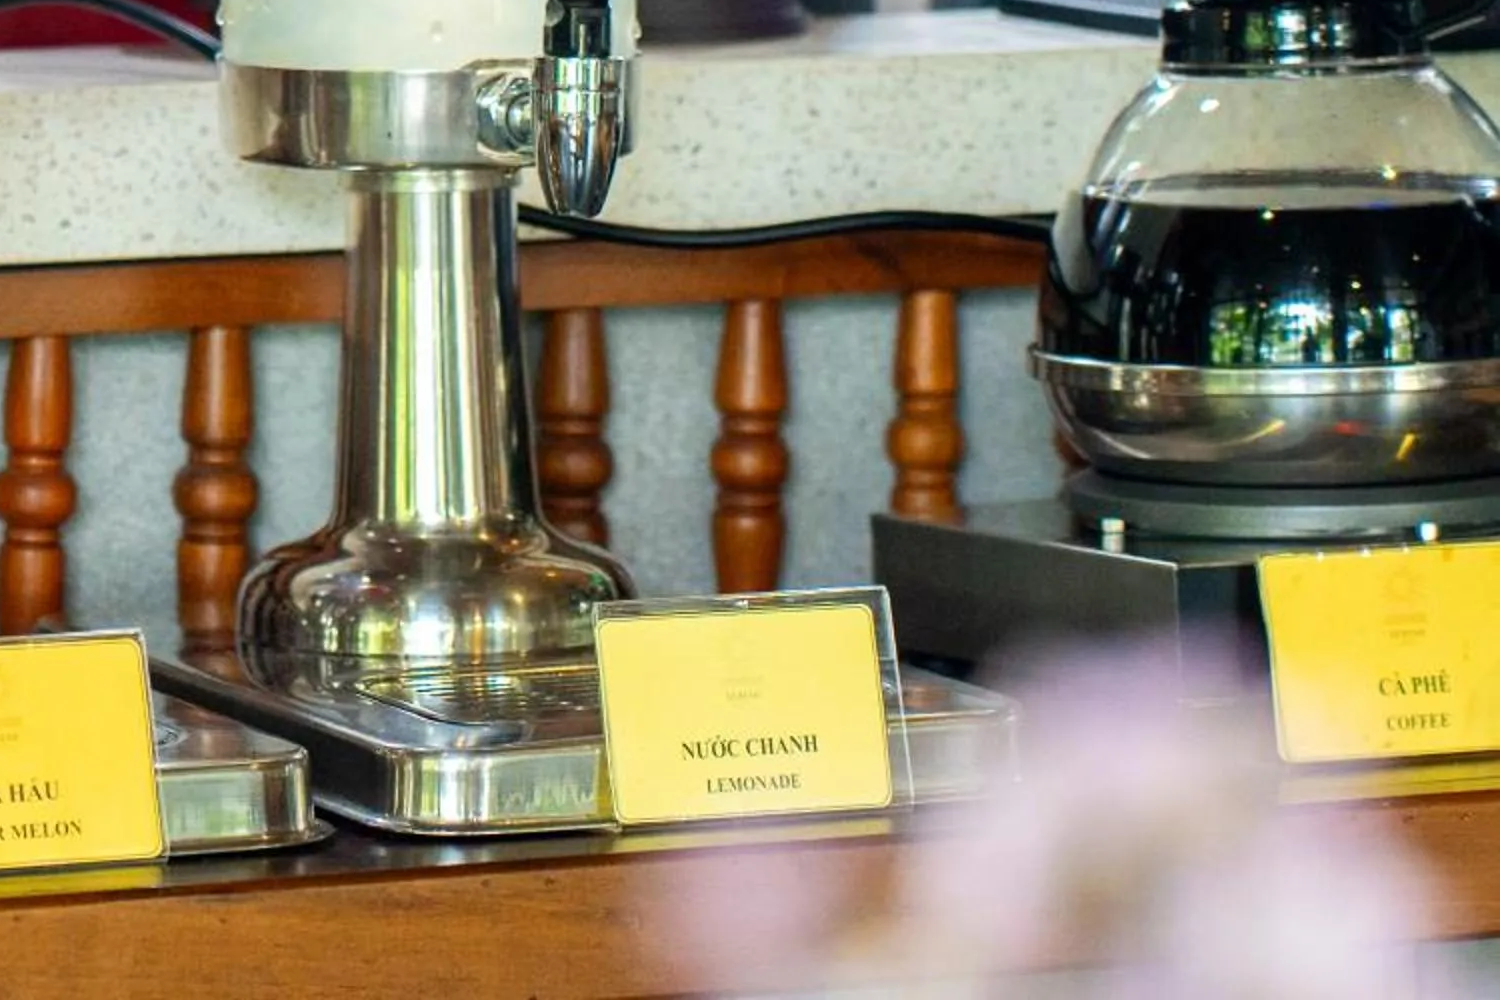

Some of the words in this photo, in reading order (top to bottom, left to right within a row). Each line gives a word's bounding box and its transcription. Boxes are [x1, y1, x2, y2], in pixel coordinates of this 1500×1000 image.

[1386, 713, 1452, 731] COFFEE
[745, 734, 818, 757] CHANH
[706, 773, 802, 794] LEMONADE
[11, 819, 82, 840] MELON
